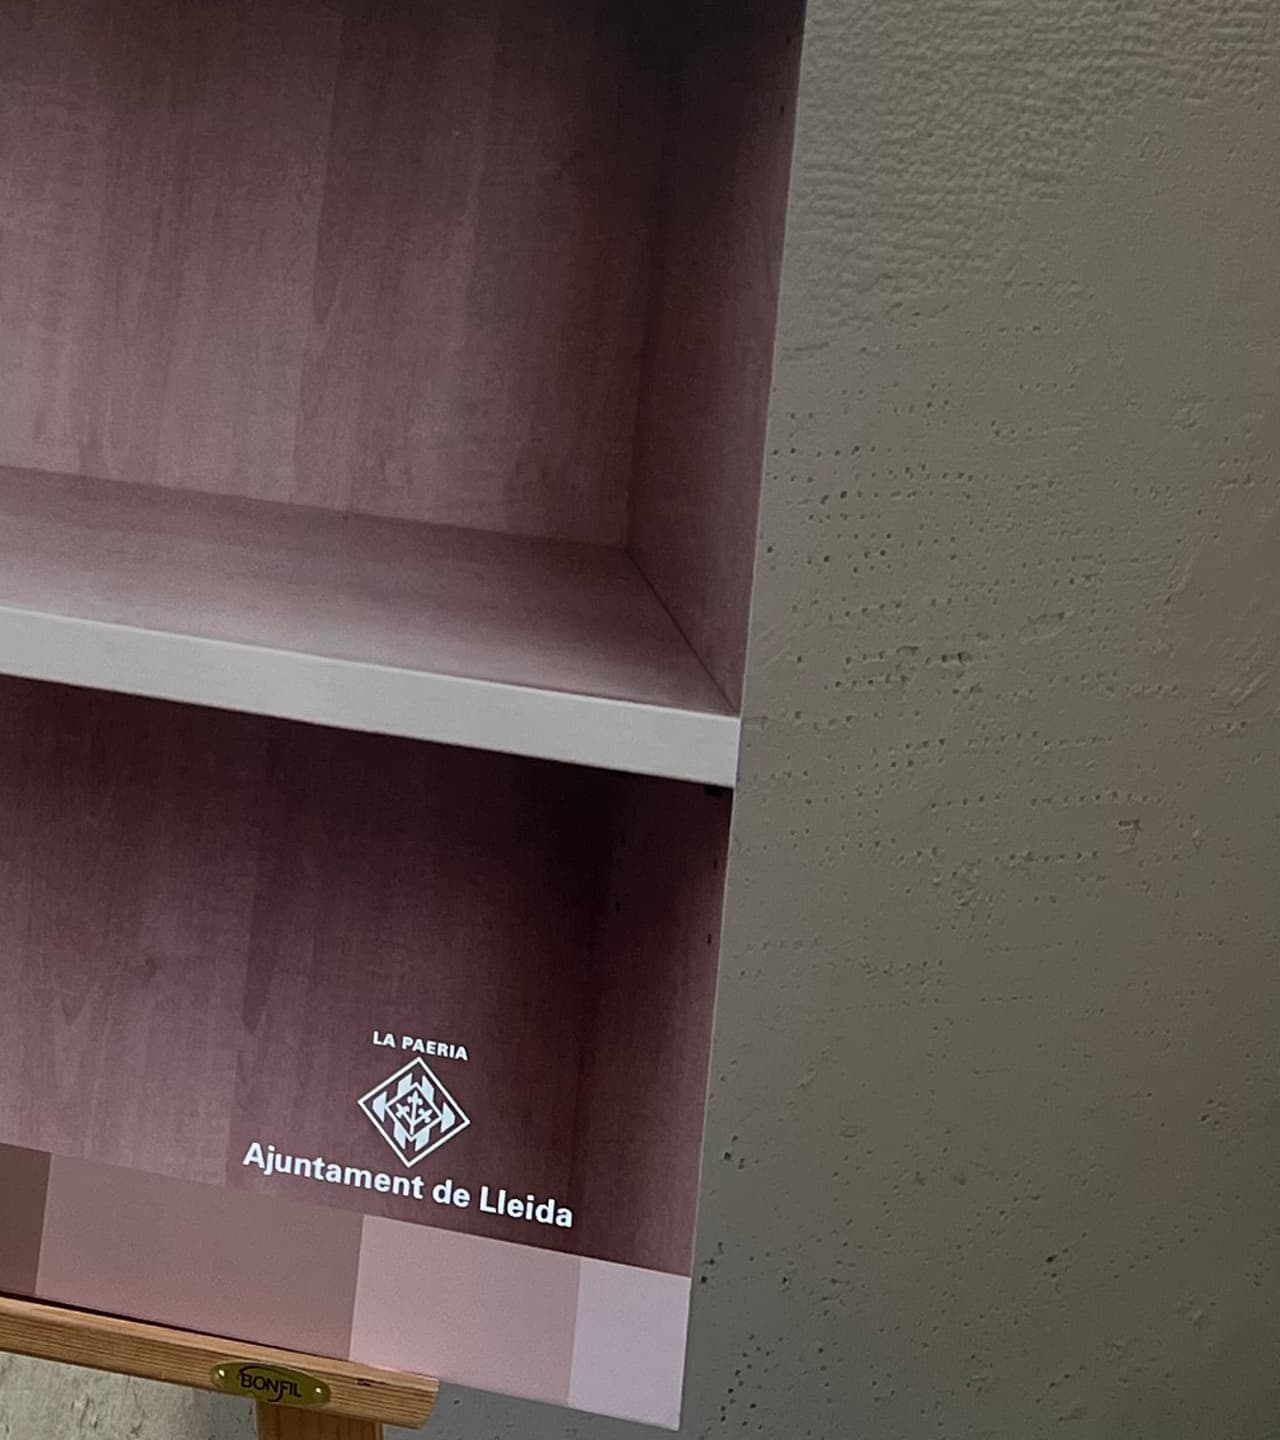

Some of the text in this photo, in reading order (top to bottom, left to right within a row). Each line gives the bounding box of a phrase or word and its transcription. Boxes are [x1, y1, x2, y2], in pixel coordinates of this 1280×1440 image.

[373, 1031, 469, 1061] LA PAERIA
[242, 1142, 574, 1229] Ajuntament de Lleida
[239, 1366, 303, 1402] BONFIL
